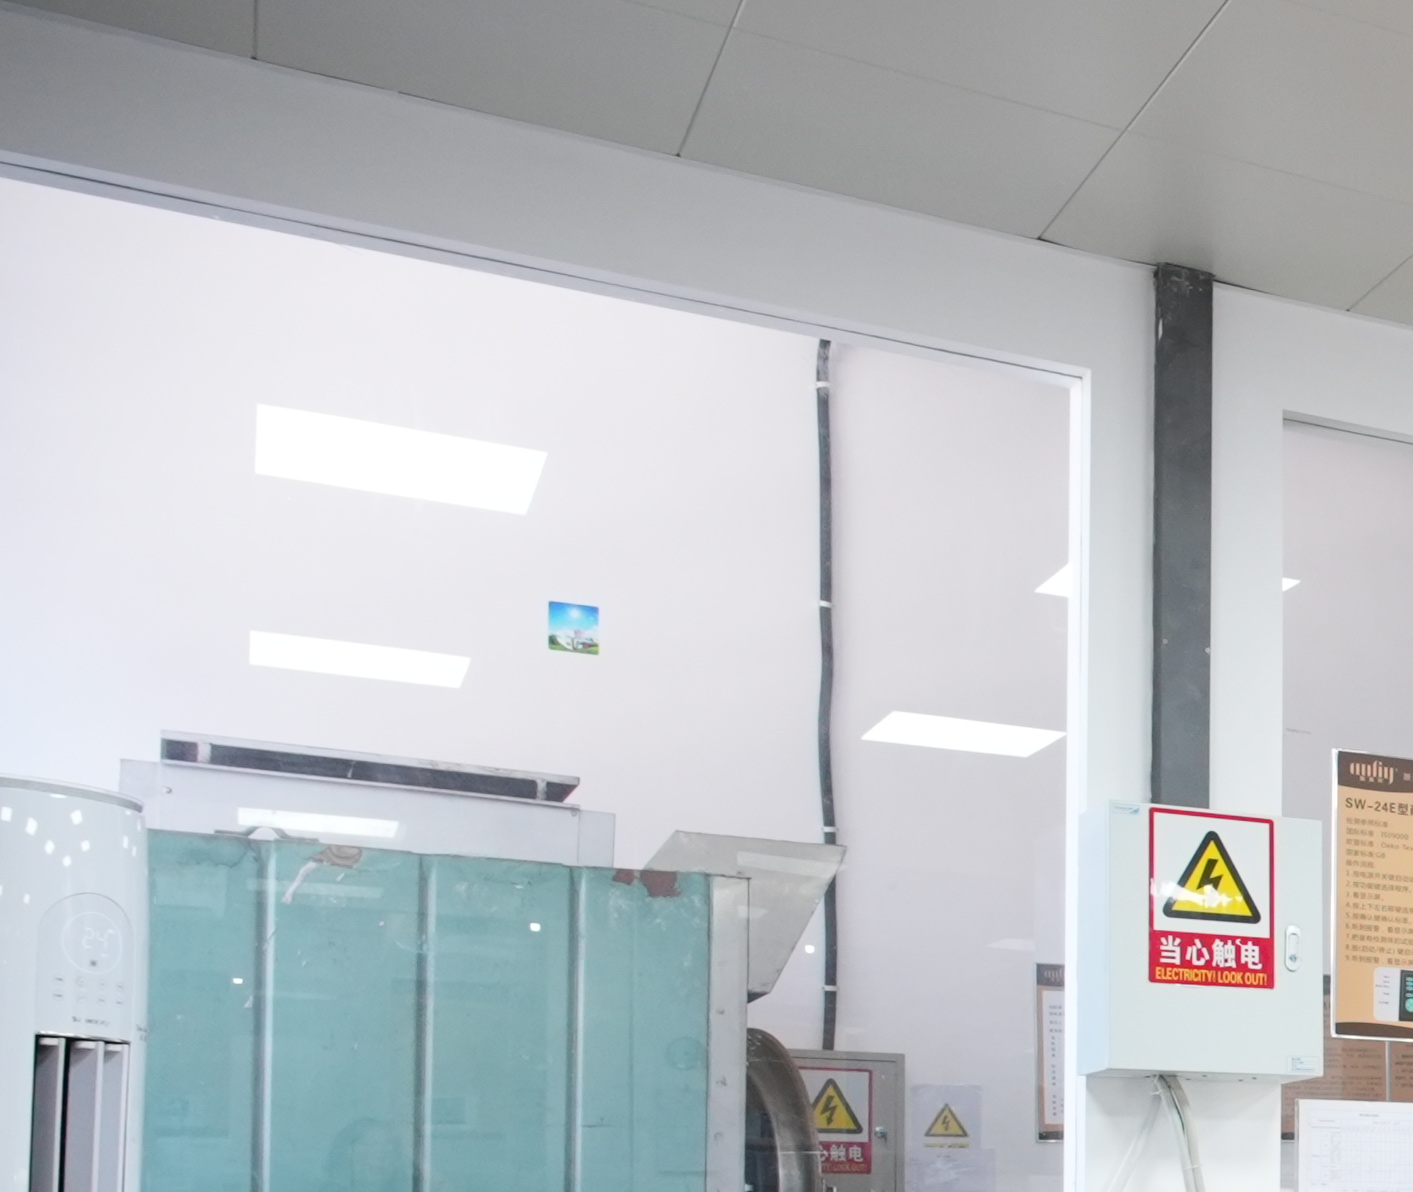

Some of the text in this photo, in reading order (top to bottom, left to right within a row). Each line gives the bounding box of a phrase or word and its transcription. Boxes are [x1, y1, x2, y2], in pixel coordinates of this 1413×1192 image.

[1159, 935, 1263, 969] 当心触电
[1156, 967, 1267, 985] ELECTRICITY! LOOK OUT!
